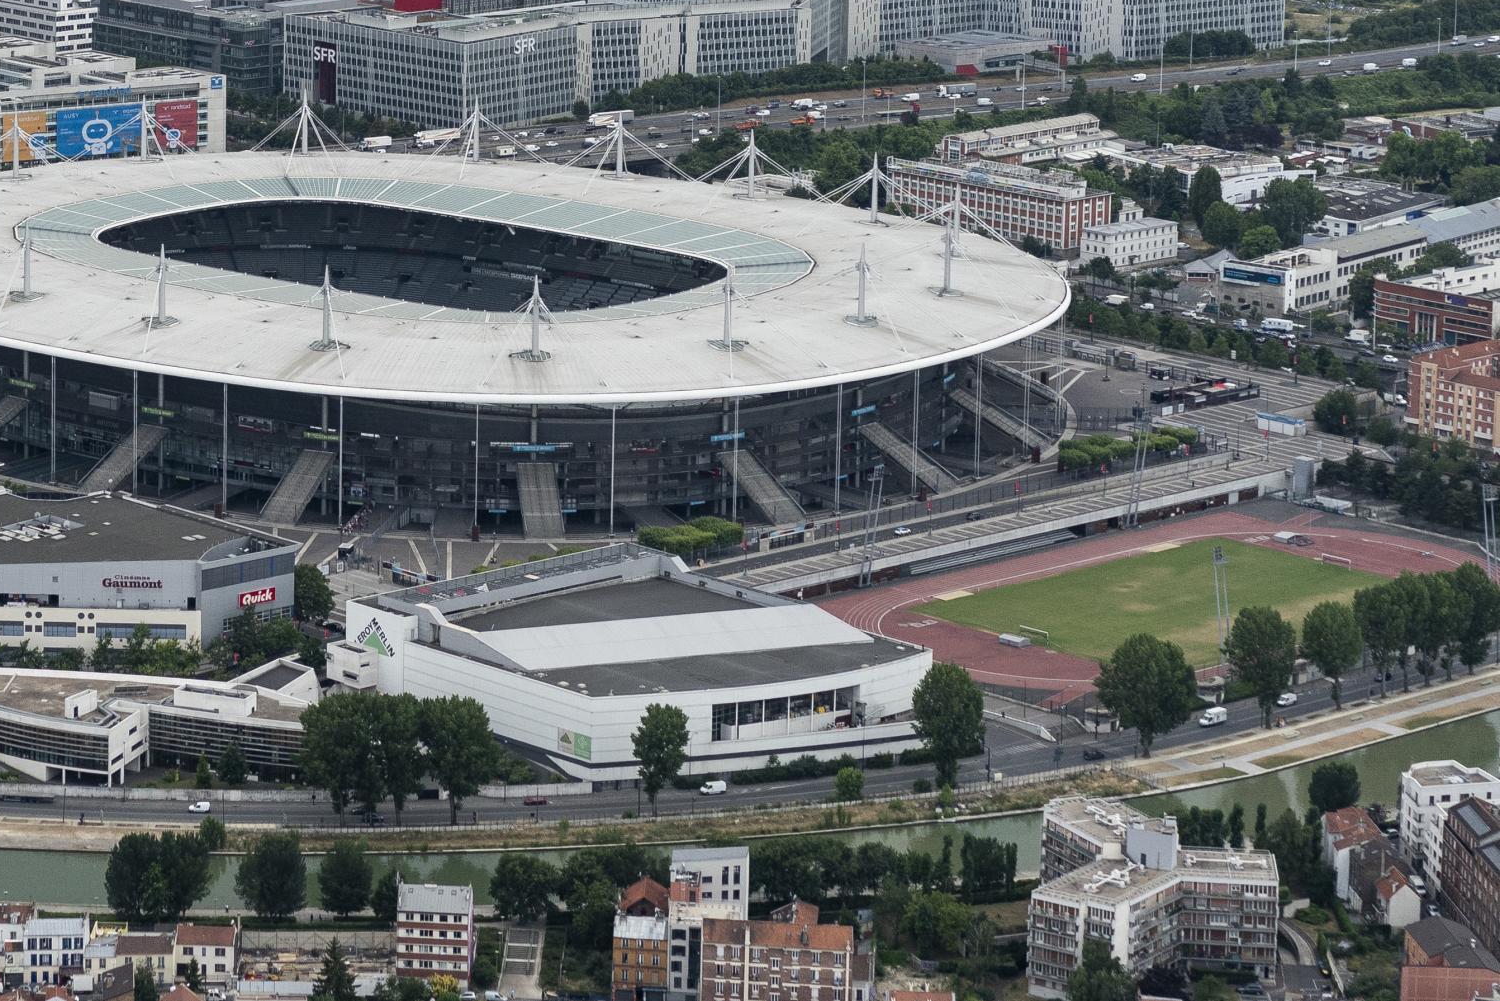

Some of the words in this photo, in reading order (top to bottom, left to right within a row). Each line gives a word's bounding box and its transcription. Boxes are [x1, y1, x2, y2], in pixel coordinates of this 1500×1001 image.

[313, 46, 336, 64] SFR
[514, 37, 536, 55] SFR
[102, 577, 163, 589] Gaumont
[242, 588, 273, 606] Quick
[354, 621, 374, 644] EROY
[371, 617, 396, 658] MERLIN
